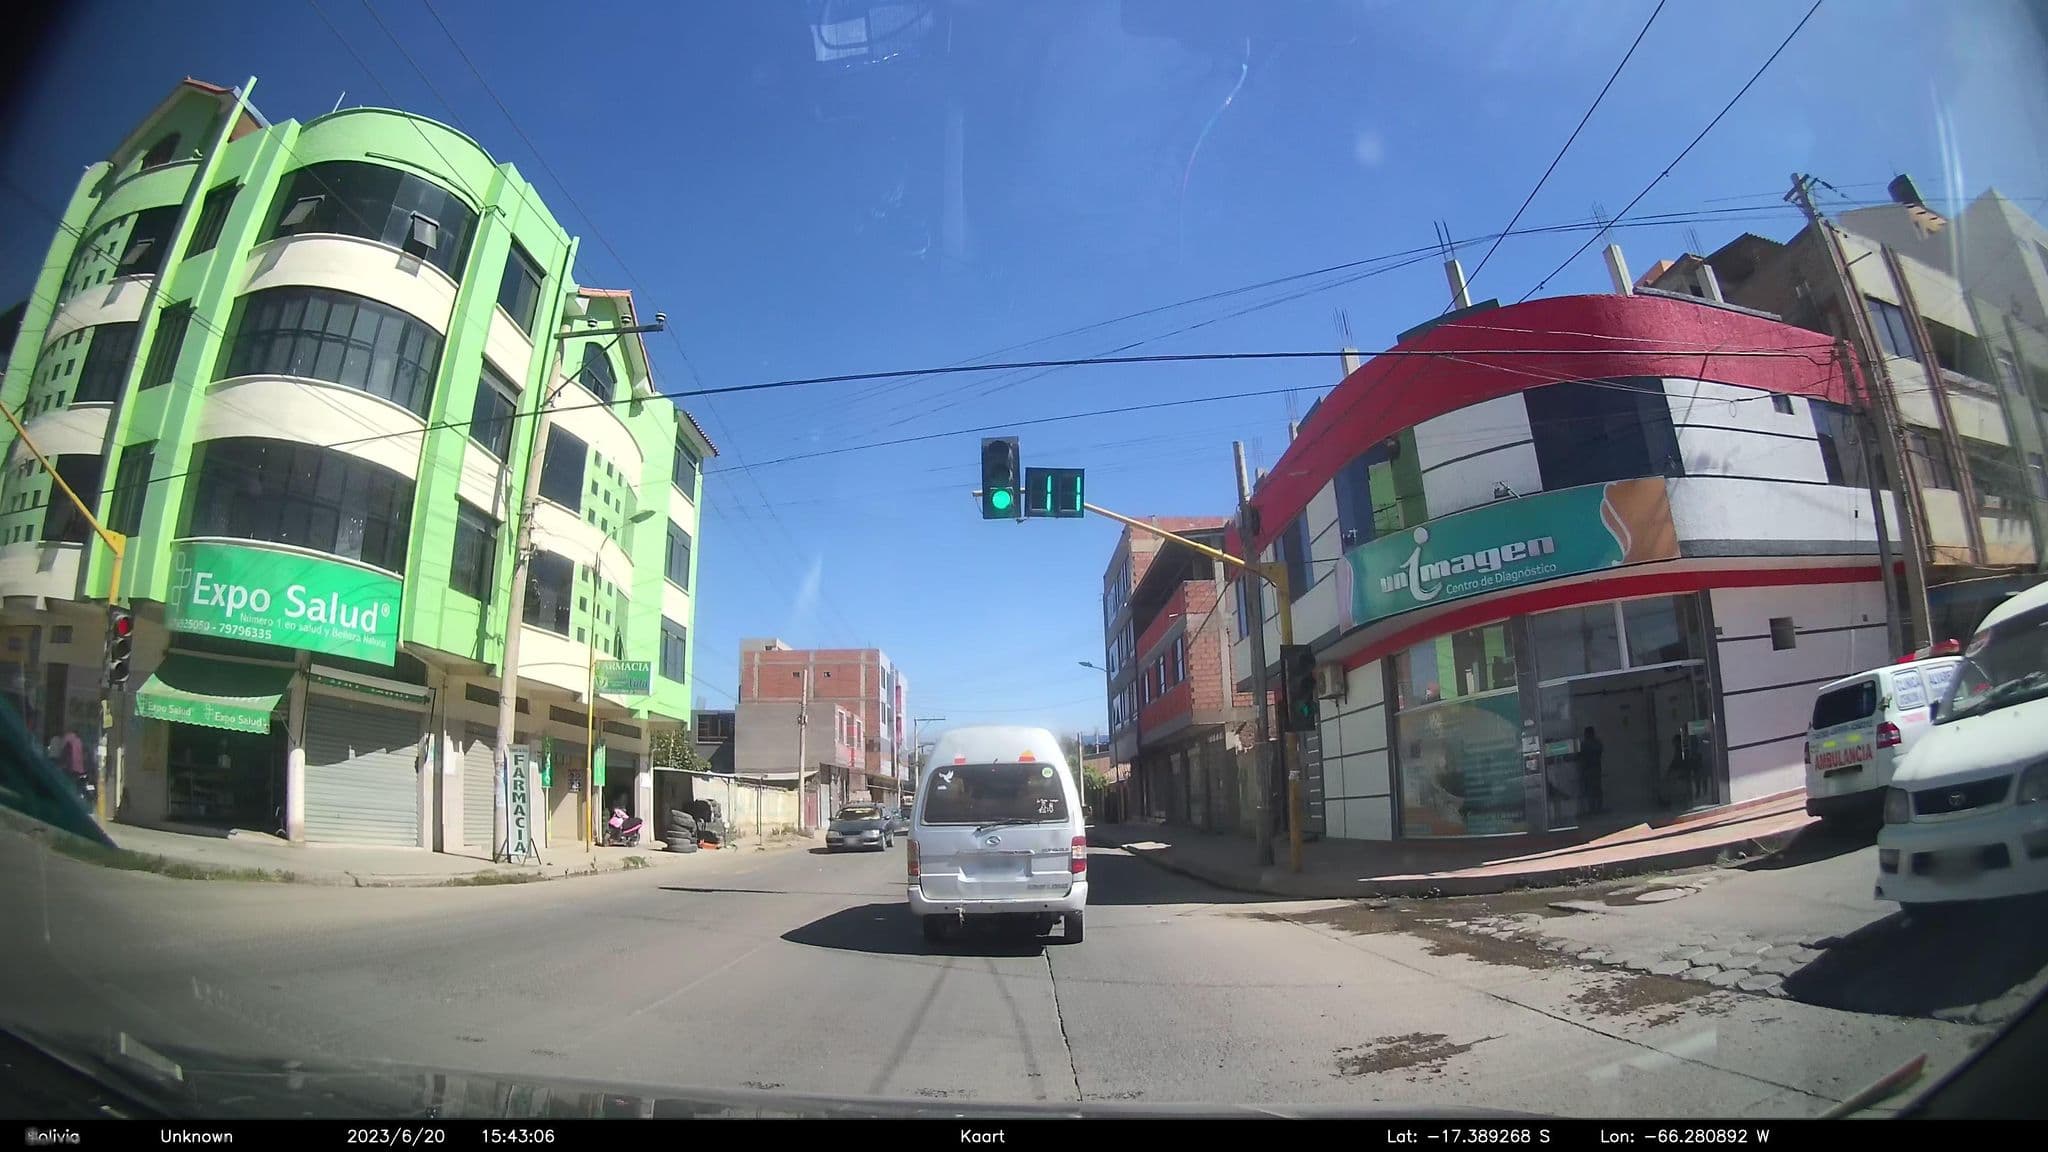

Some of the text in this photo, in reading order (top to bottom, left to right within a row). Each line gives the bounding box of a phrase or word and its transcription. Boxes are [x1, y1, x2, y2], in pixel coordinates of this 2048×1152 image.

[1046, 475, 1081, 512] 11
[1446, 563, 1557, 595] Centro de Diagnóstico
[192, 571, 272, 618] Expo
[219, 622, 273, 640] 79796335
[284, 621, 296, 630] en
[168, 704, 192, 717] Salud
[214, 711, 263, 727] Expo Salud
[1815, 743, 1874, 771] AMBULANCIA
[511, 754, 527, 854] FARMACIA
